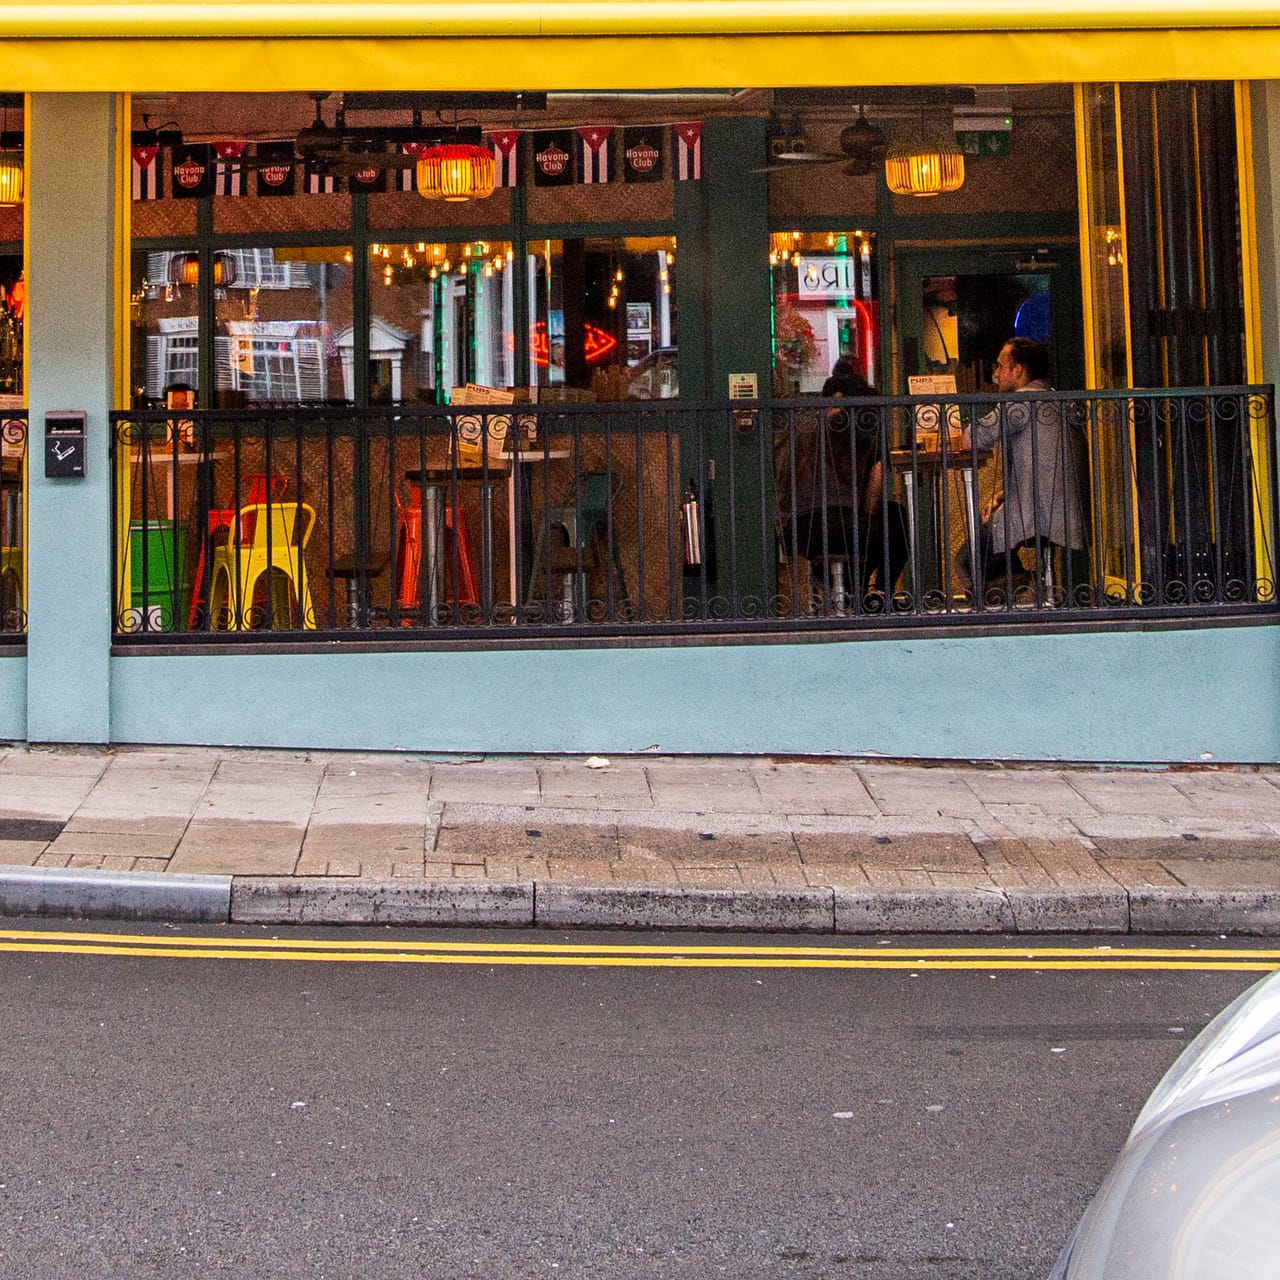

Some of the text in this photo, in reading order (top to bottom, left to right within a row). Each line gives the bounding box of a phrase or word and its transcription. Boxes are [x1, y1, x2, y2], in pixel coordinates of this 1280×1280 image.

[536, 152, 569, 162] Havana
[627, 149, 659, 159] Havana
[543, 162, 563, 171] Club
[633, 158, 653, 167] Club
[174, 166, 205, 175] Havana
[180, 174, 199, 183] Club
[265, 172, 284, 182] Club
